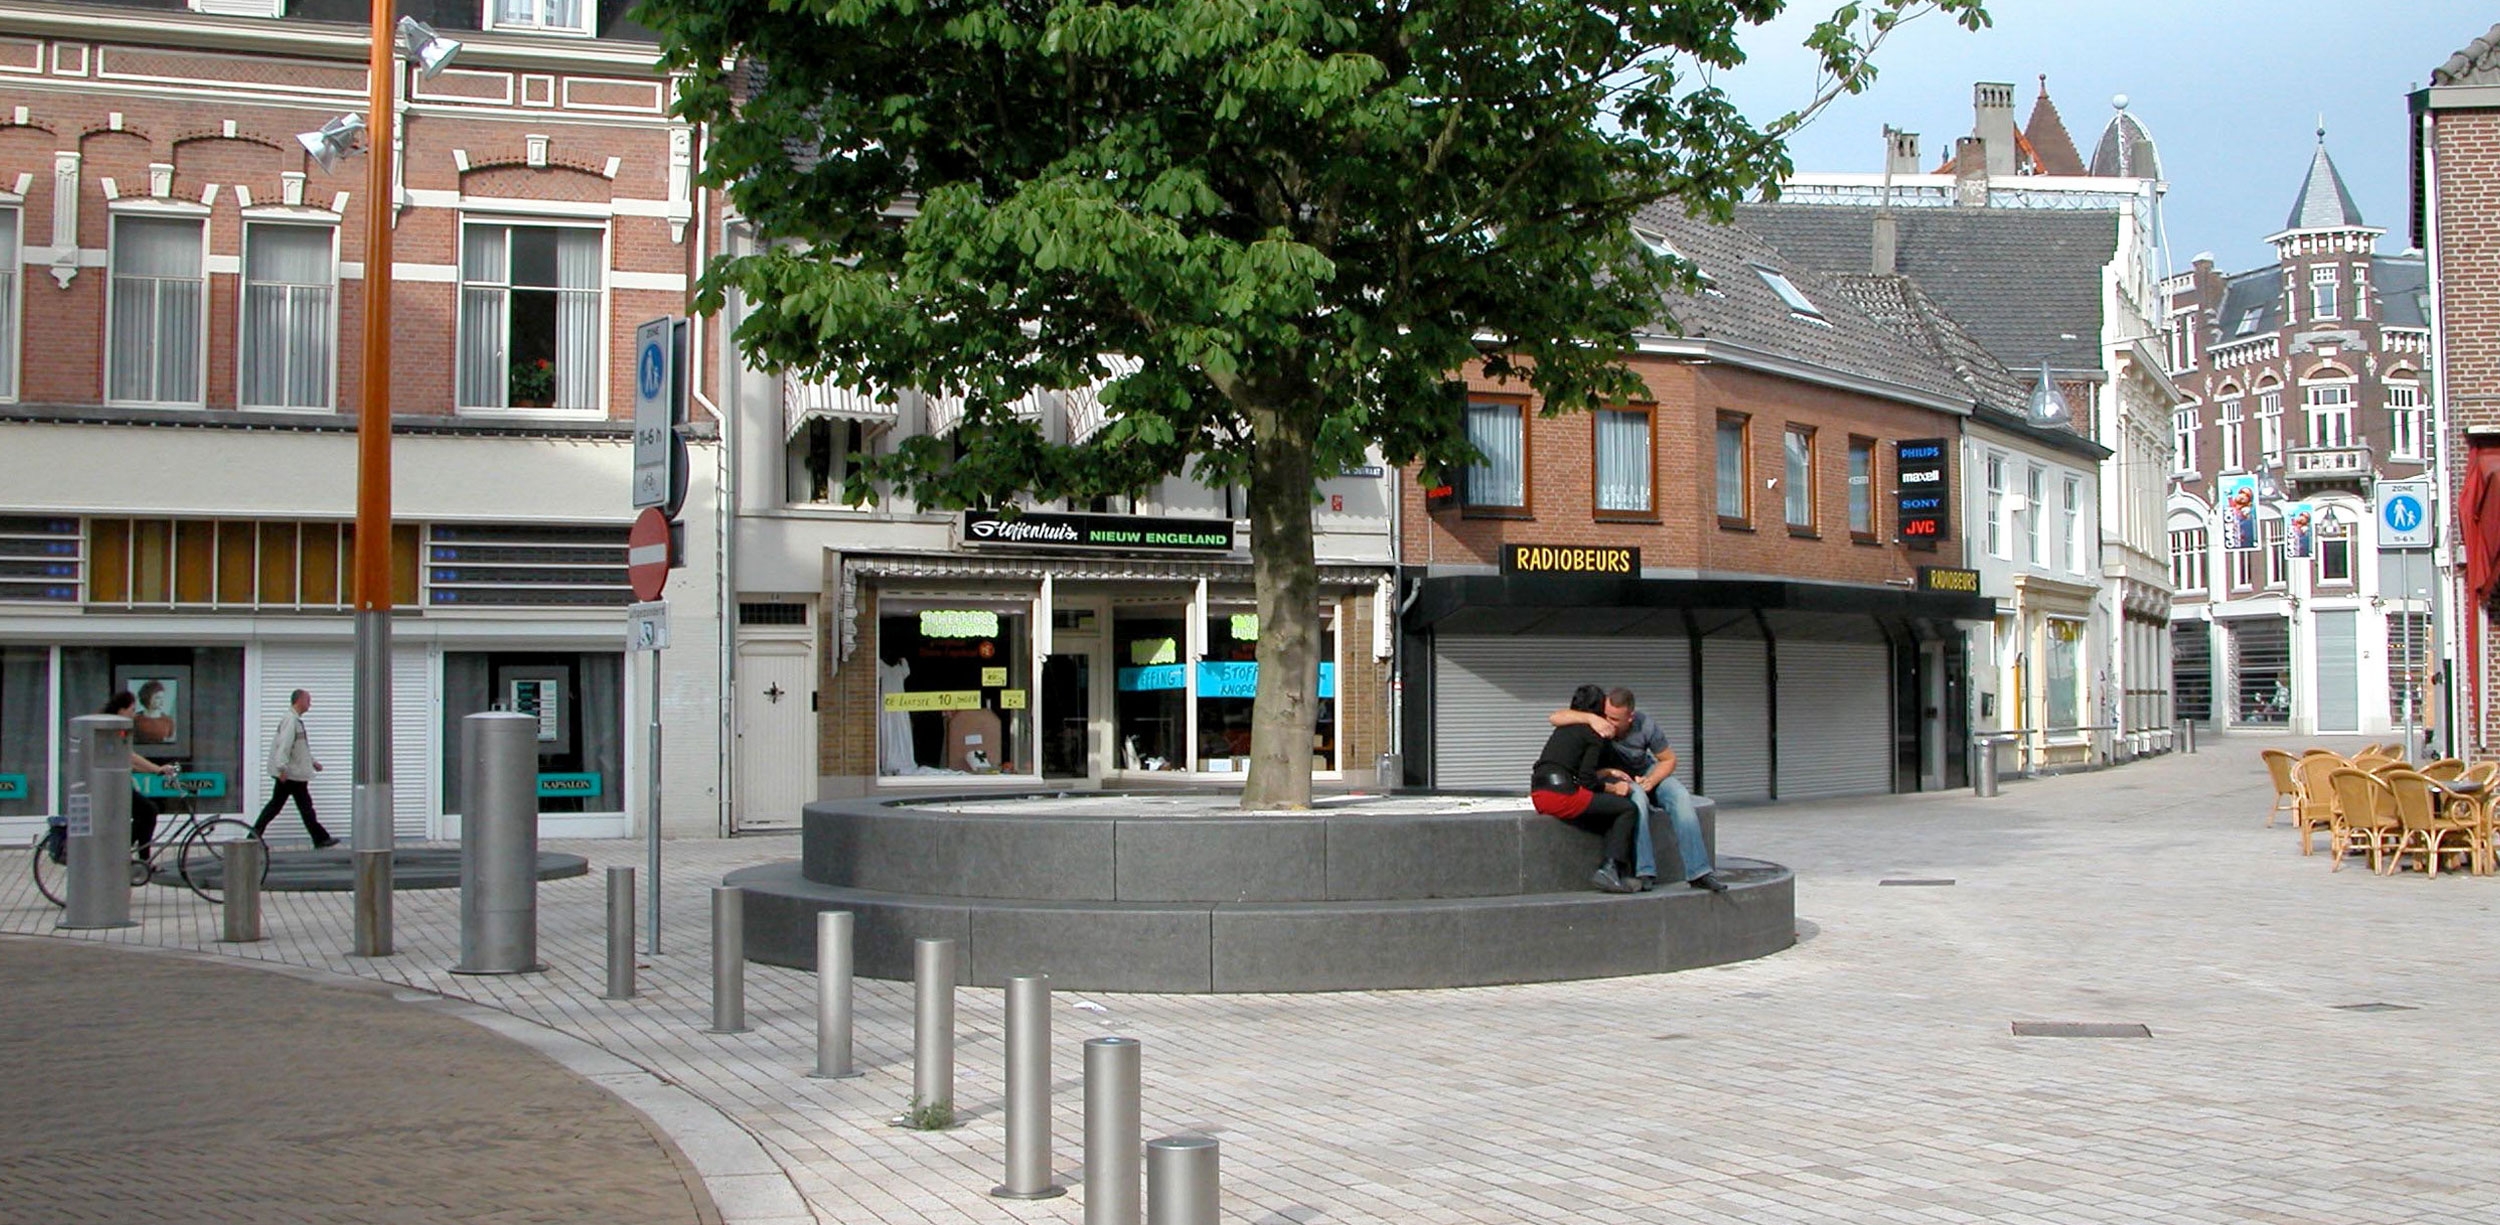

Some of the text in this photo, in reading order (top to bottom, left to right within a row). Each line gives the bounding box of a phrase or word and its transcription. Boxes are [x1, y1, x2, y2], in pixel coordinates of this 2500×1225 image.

[1901, 447, 1939, 458] PHILIPS
[1902, 470, 1940, 483] maxell
[1901, 499, 1940, 509] SONY
[1906, 521, 1935, 534] JVC
[1089, 530, 1228, 545] NIEUW ENGELAND
[1517, 547, 1631, 573] RADIOBEURS
[1930, 569, 1977, 591] RADIOBEURS
[939, 694, 951, 705] 10
[542, 780, 591, 790] KAPSALON
